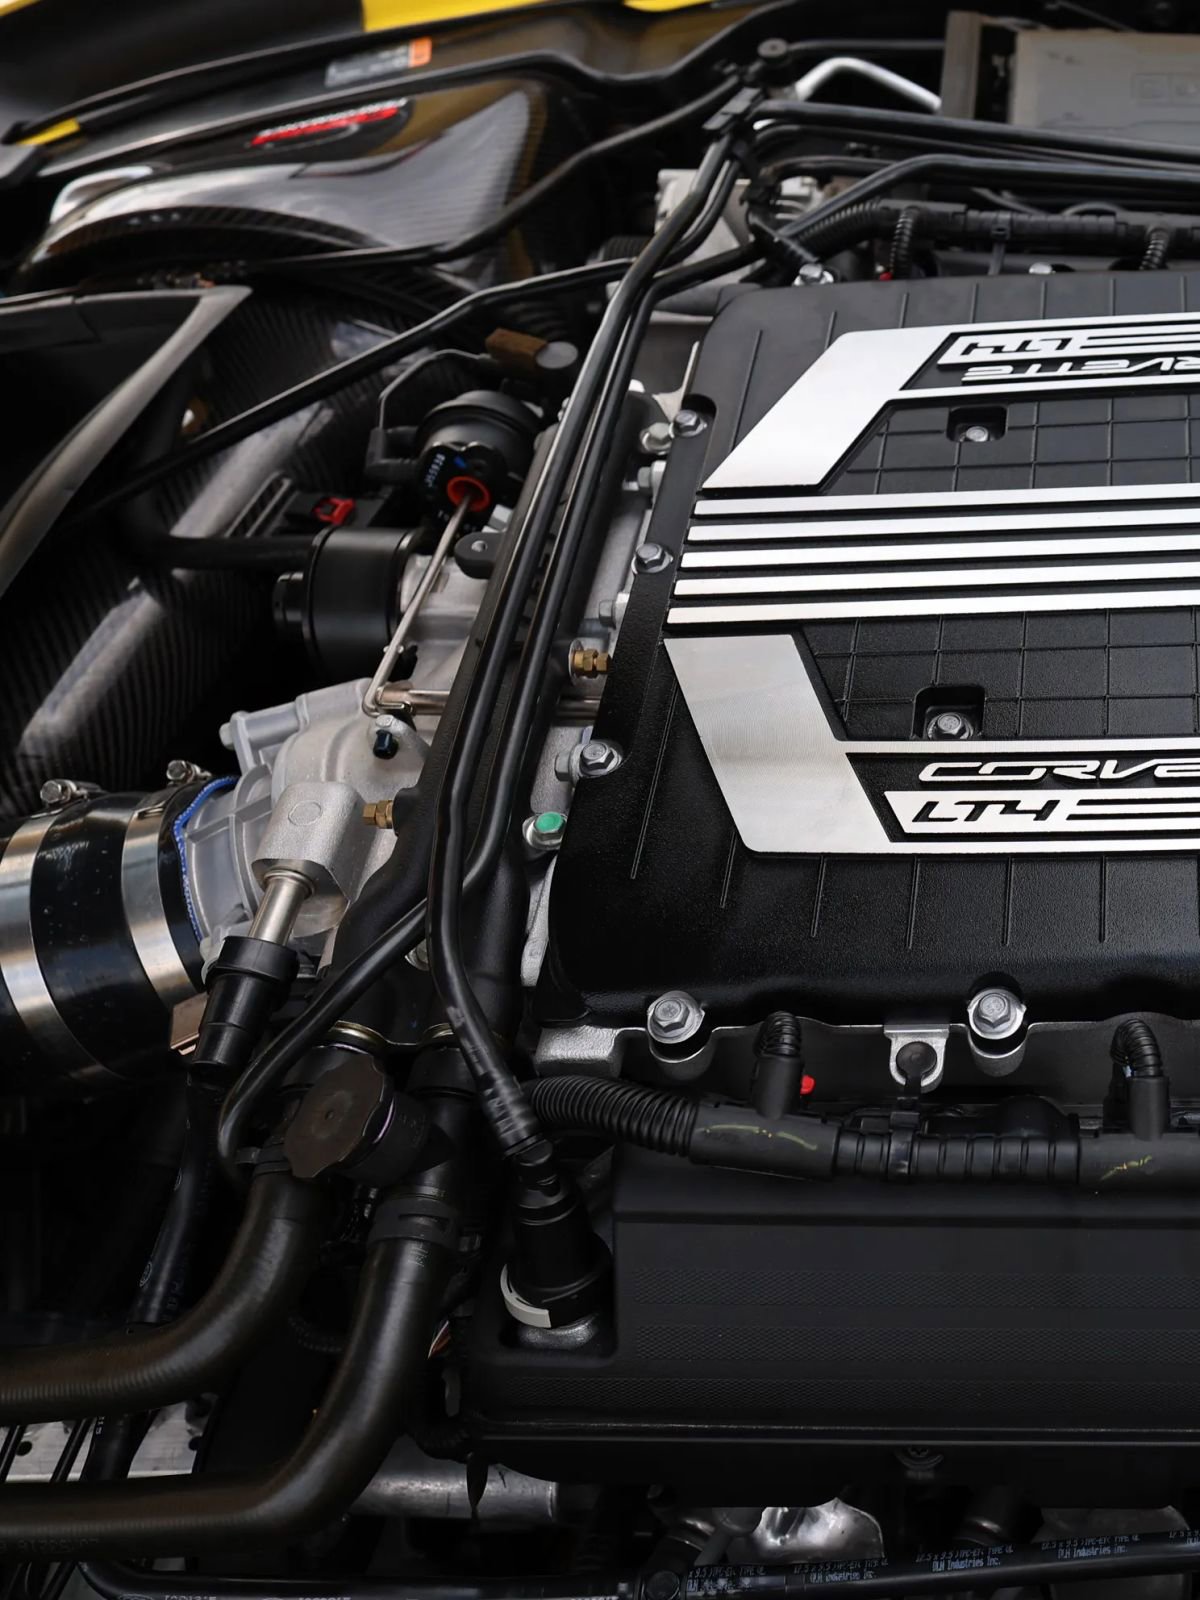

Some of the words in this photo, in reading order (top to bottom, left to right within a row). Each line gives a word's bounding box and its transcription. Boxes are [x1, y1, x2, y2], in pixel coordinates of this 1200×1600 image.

[961, 338, 1074, 356] LT4
[911, 800, 1061, 823] LT4
[1073, 1545, 1111, 1557] Industries
[947, 1557, 984, 1570] Industries
